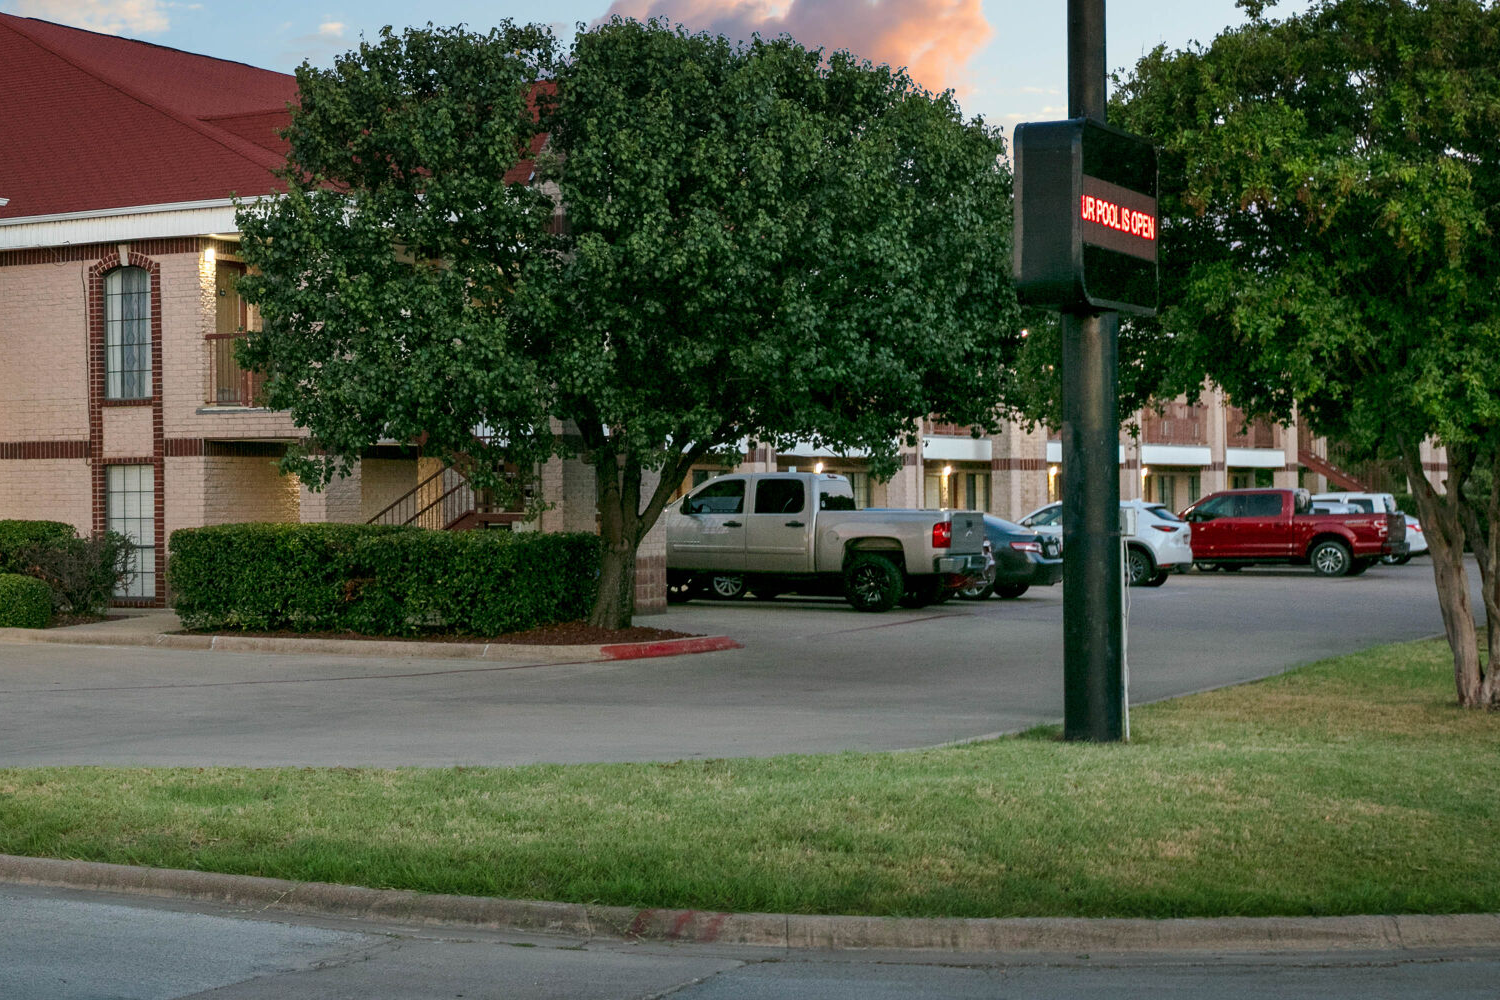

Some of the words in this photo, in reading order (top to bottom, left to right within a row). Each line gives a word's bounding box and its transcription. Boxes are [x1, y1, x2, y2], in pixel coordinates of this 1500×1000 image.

[1081, 194, 1096, 222] UR
[1096, 199, 1121, 231] POOL
[1121, 207, 1131, 234] IS
[1131, 210, 1155, 240] OPEN
